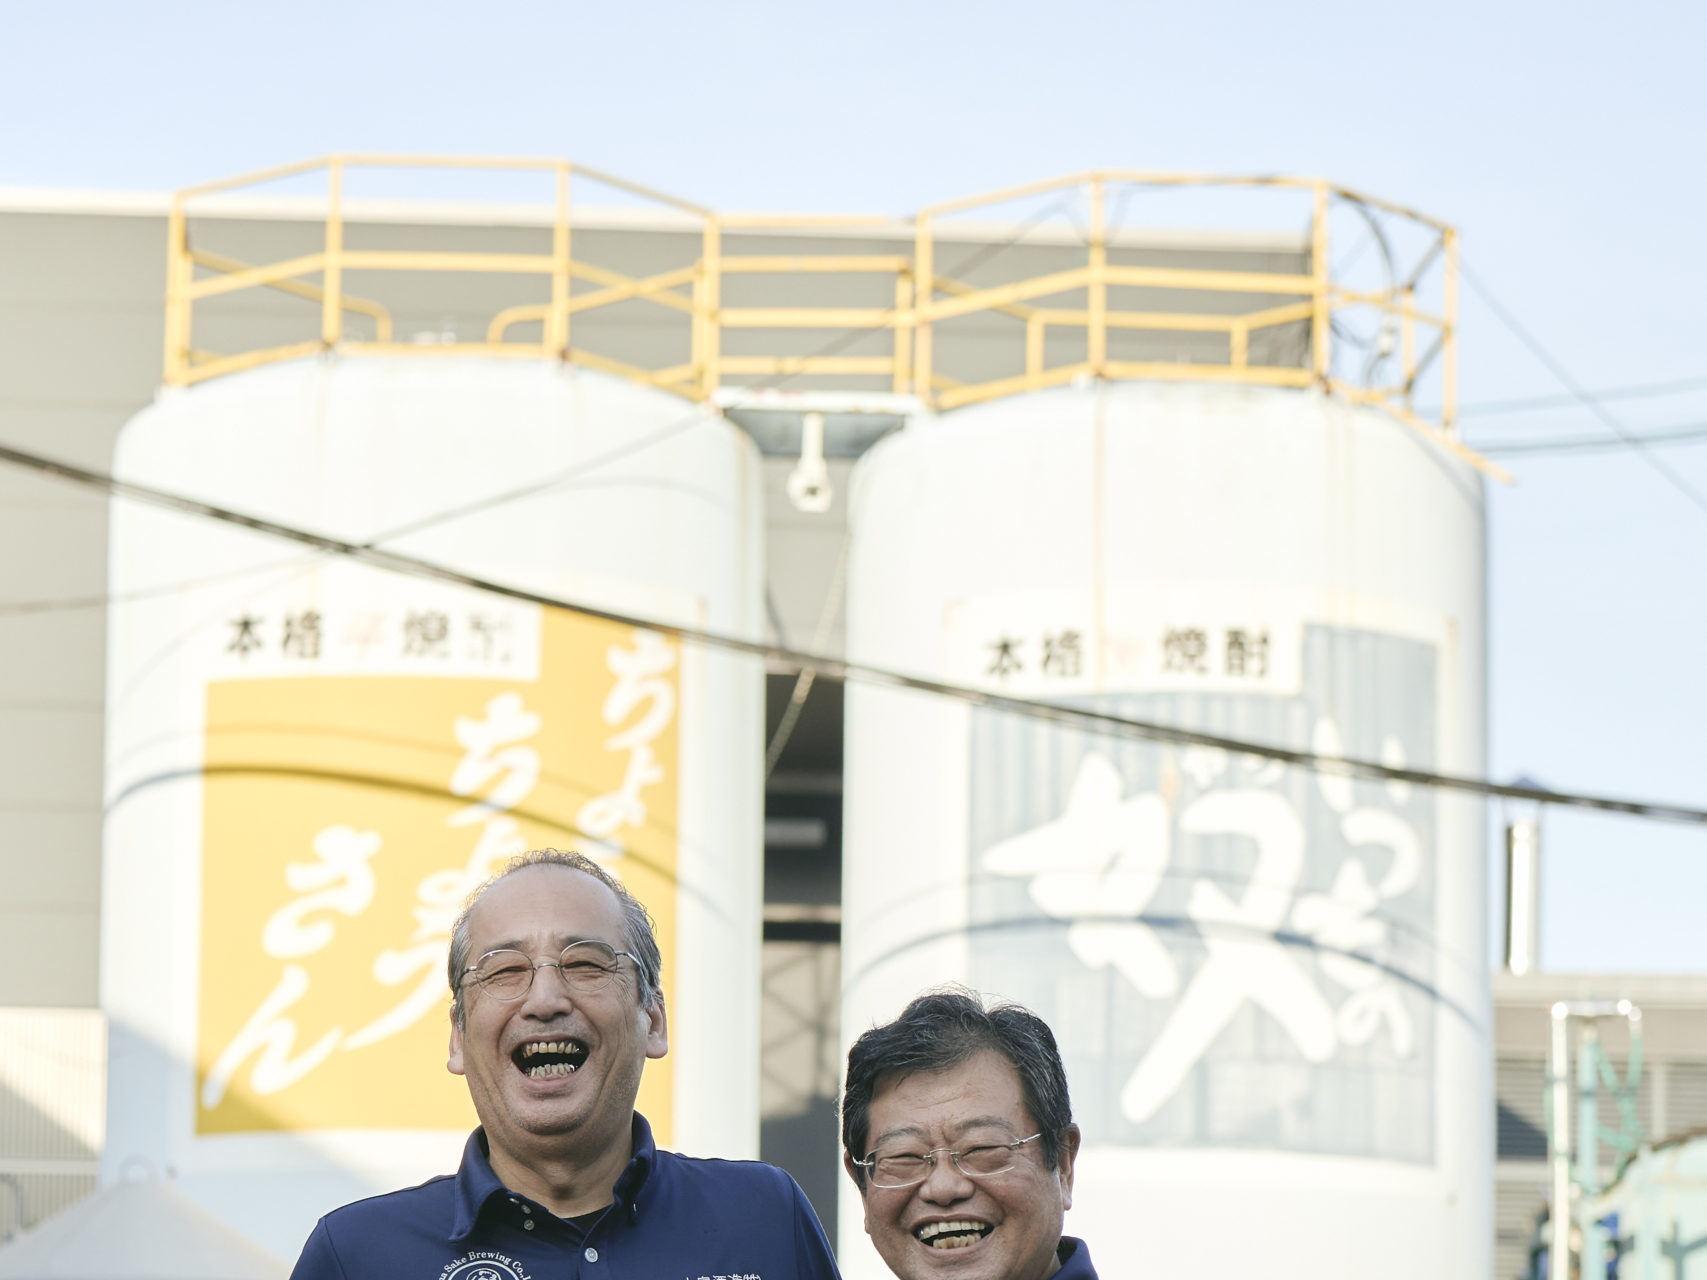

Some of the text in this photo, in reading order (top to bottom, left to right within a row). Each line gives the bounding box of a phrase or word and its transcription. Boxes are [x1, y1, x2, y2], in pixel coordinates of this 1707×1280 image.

[227, 609, 513, 665] 本格焼酎
[985, 627, 1271, 680] 本格焼酎
[443, 1256, 467, 1273] Sake
[467, 1251, 512, 1266] Brewing
